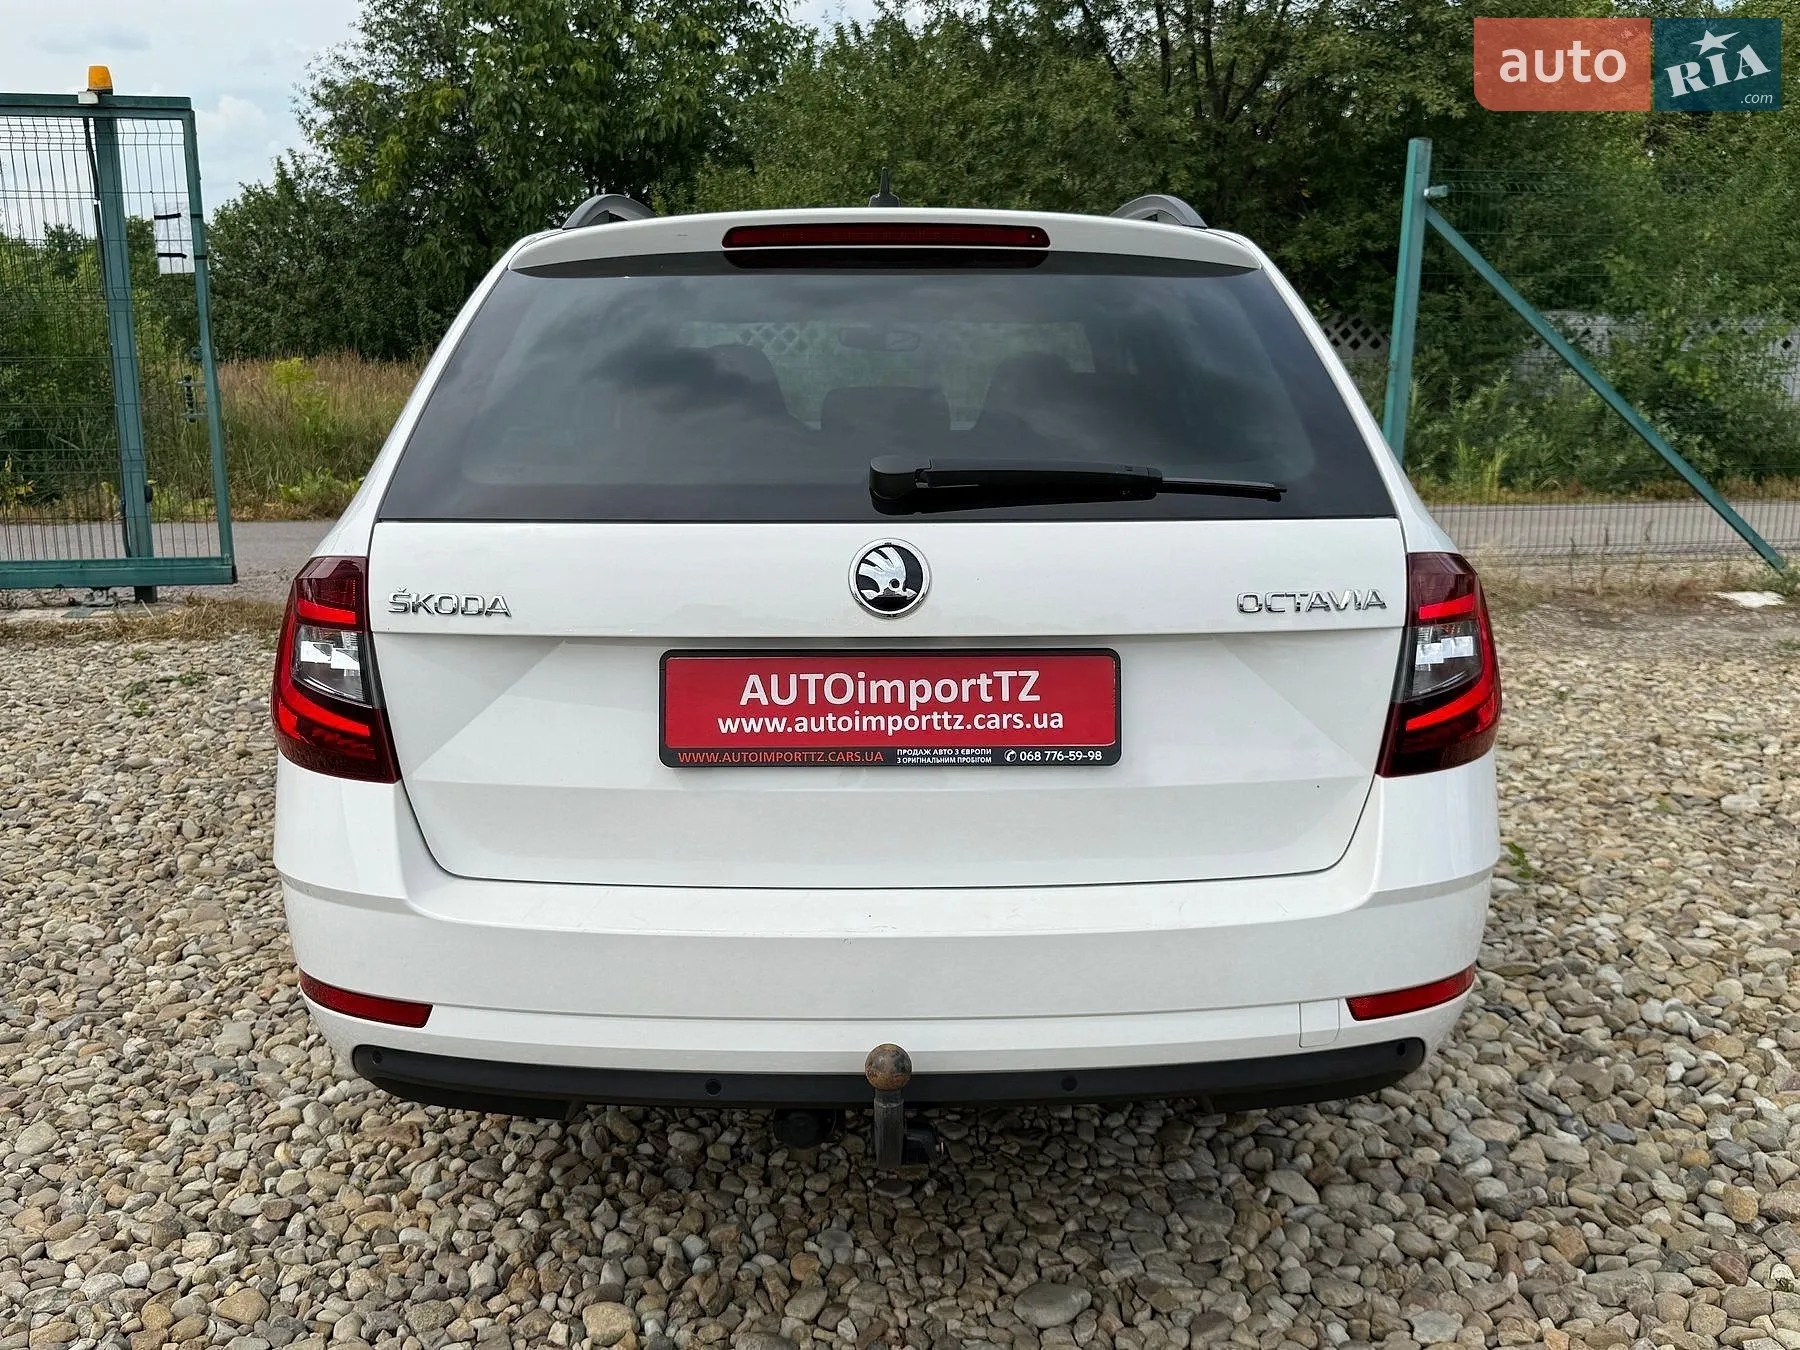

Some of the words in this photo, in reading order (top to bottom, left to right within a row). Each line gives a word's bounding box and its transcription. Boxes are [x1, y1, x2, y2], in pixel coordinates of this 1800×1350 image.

[388, 587, 512, 617] ŠKODA
[1237, 589, 1387, 613] OCTAVIA
[739, 670, 1041, 711] AUTOimportTZ
[718, 710, 1064, 735] www.autoimporttz.cars.ua
[678, 751, 884, 763] WWW.AUTOIMPORTTZ.CARS.UA
[1019, 751, 1041, 761] 068
[1044, 750, 1102, 761] 776-59-98
